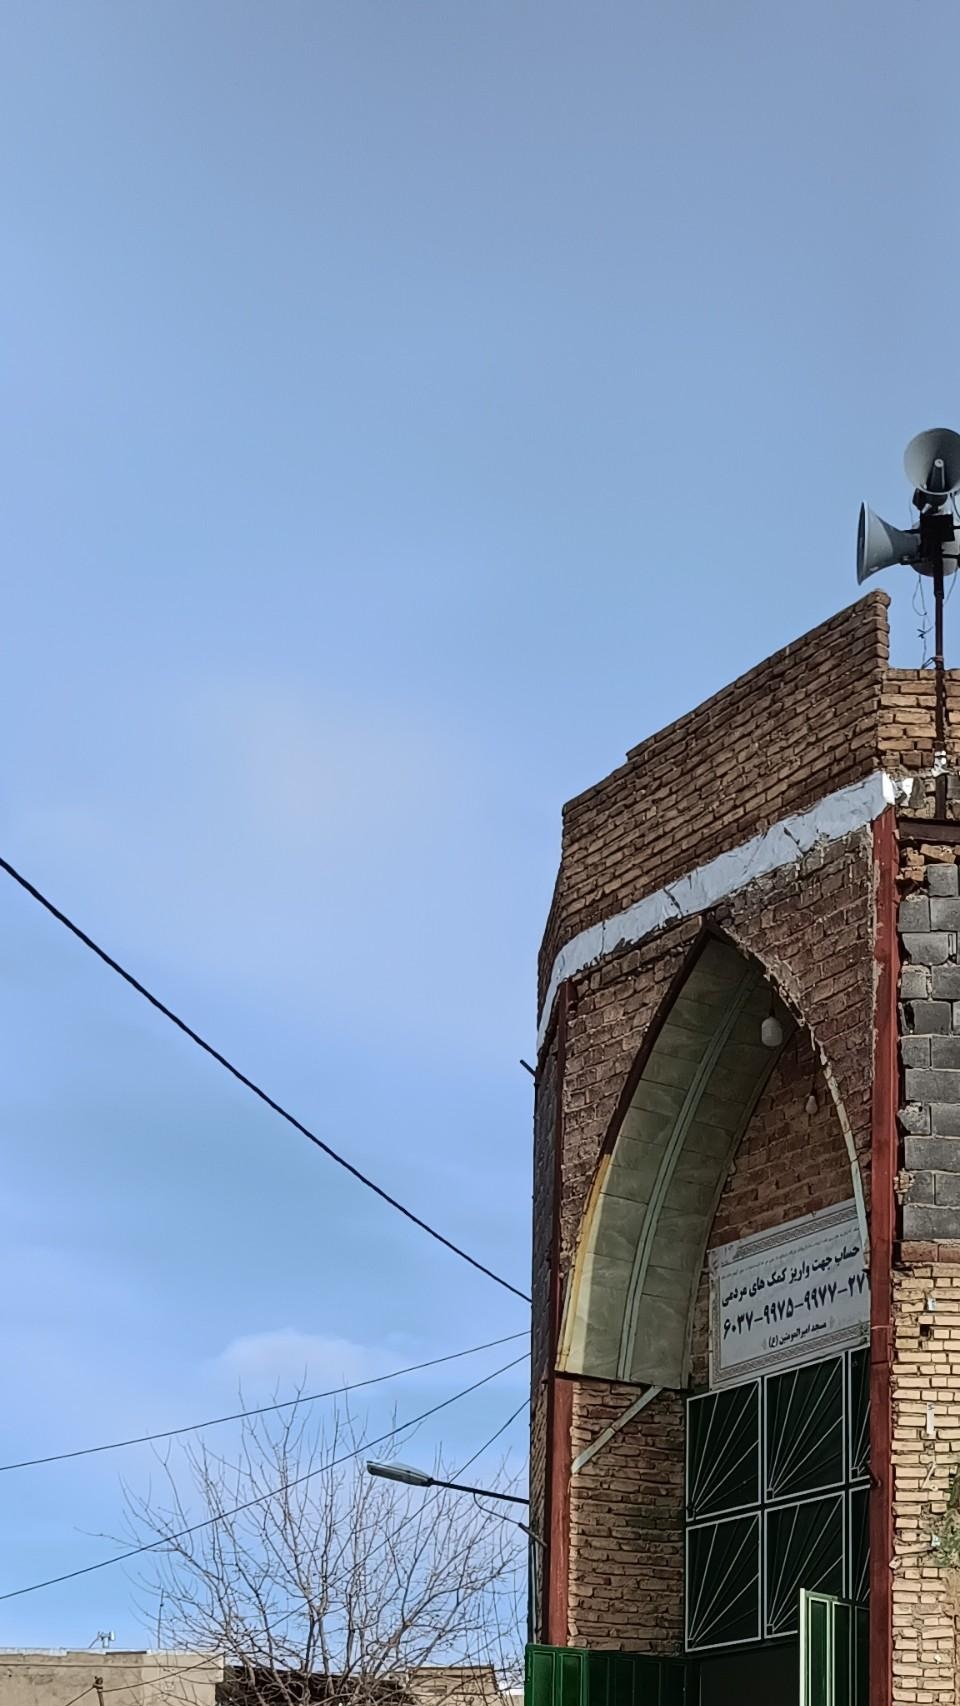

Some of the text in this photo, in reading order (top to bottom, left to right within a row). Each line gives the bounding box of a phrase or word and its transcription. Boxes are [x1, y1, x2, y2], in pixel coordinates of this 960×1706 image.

[721, 1246, 860, 1307] حساب جهت واریز کمک های مردمی
